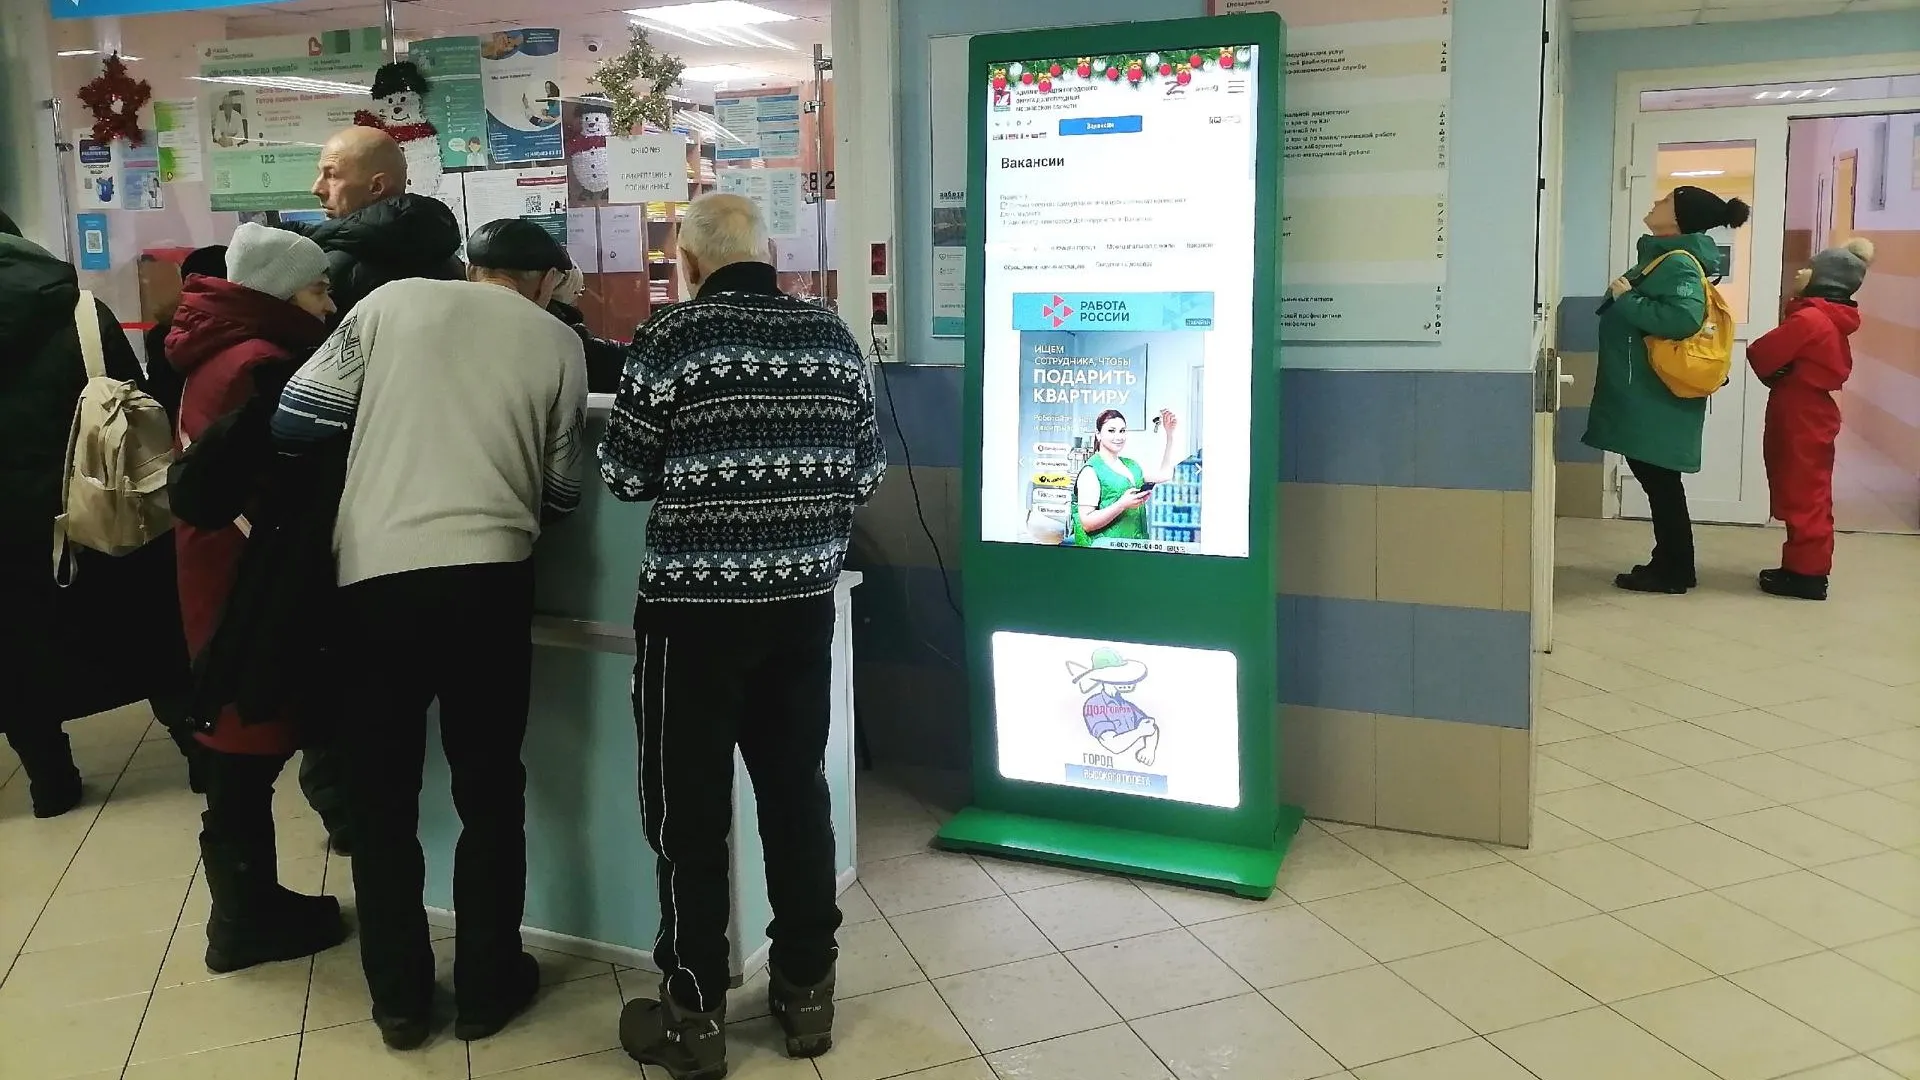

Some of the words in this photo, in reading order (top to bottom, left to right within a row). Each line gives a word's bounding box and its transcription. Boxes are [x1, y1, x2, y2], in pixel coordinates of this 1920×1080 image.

[1001, 157, 1065, 169] Вакансии
[1080, 300, 1127, 311] РАБОТА
[1080, 312, 1130, 322] РОССИИ
[1034, 345, 1065, 354] ИЩЕМ
[1034, 356, 1098, 366] СОТРУДНИКА,
[1098, 357, 1131, 366] ЧТОБЫ
[1033, 368, 1138, 387] ПОДАРИТЬ
[1033, 388, 1131, 405] КВАРТИРУ
[1083, 752, 1114, 769] ГОРОД
